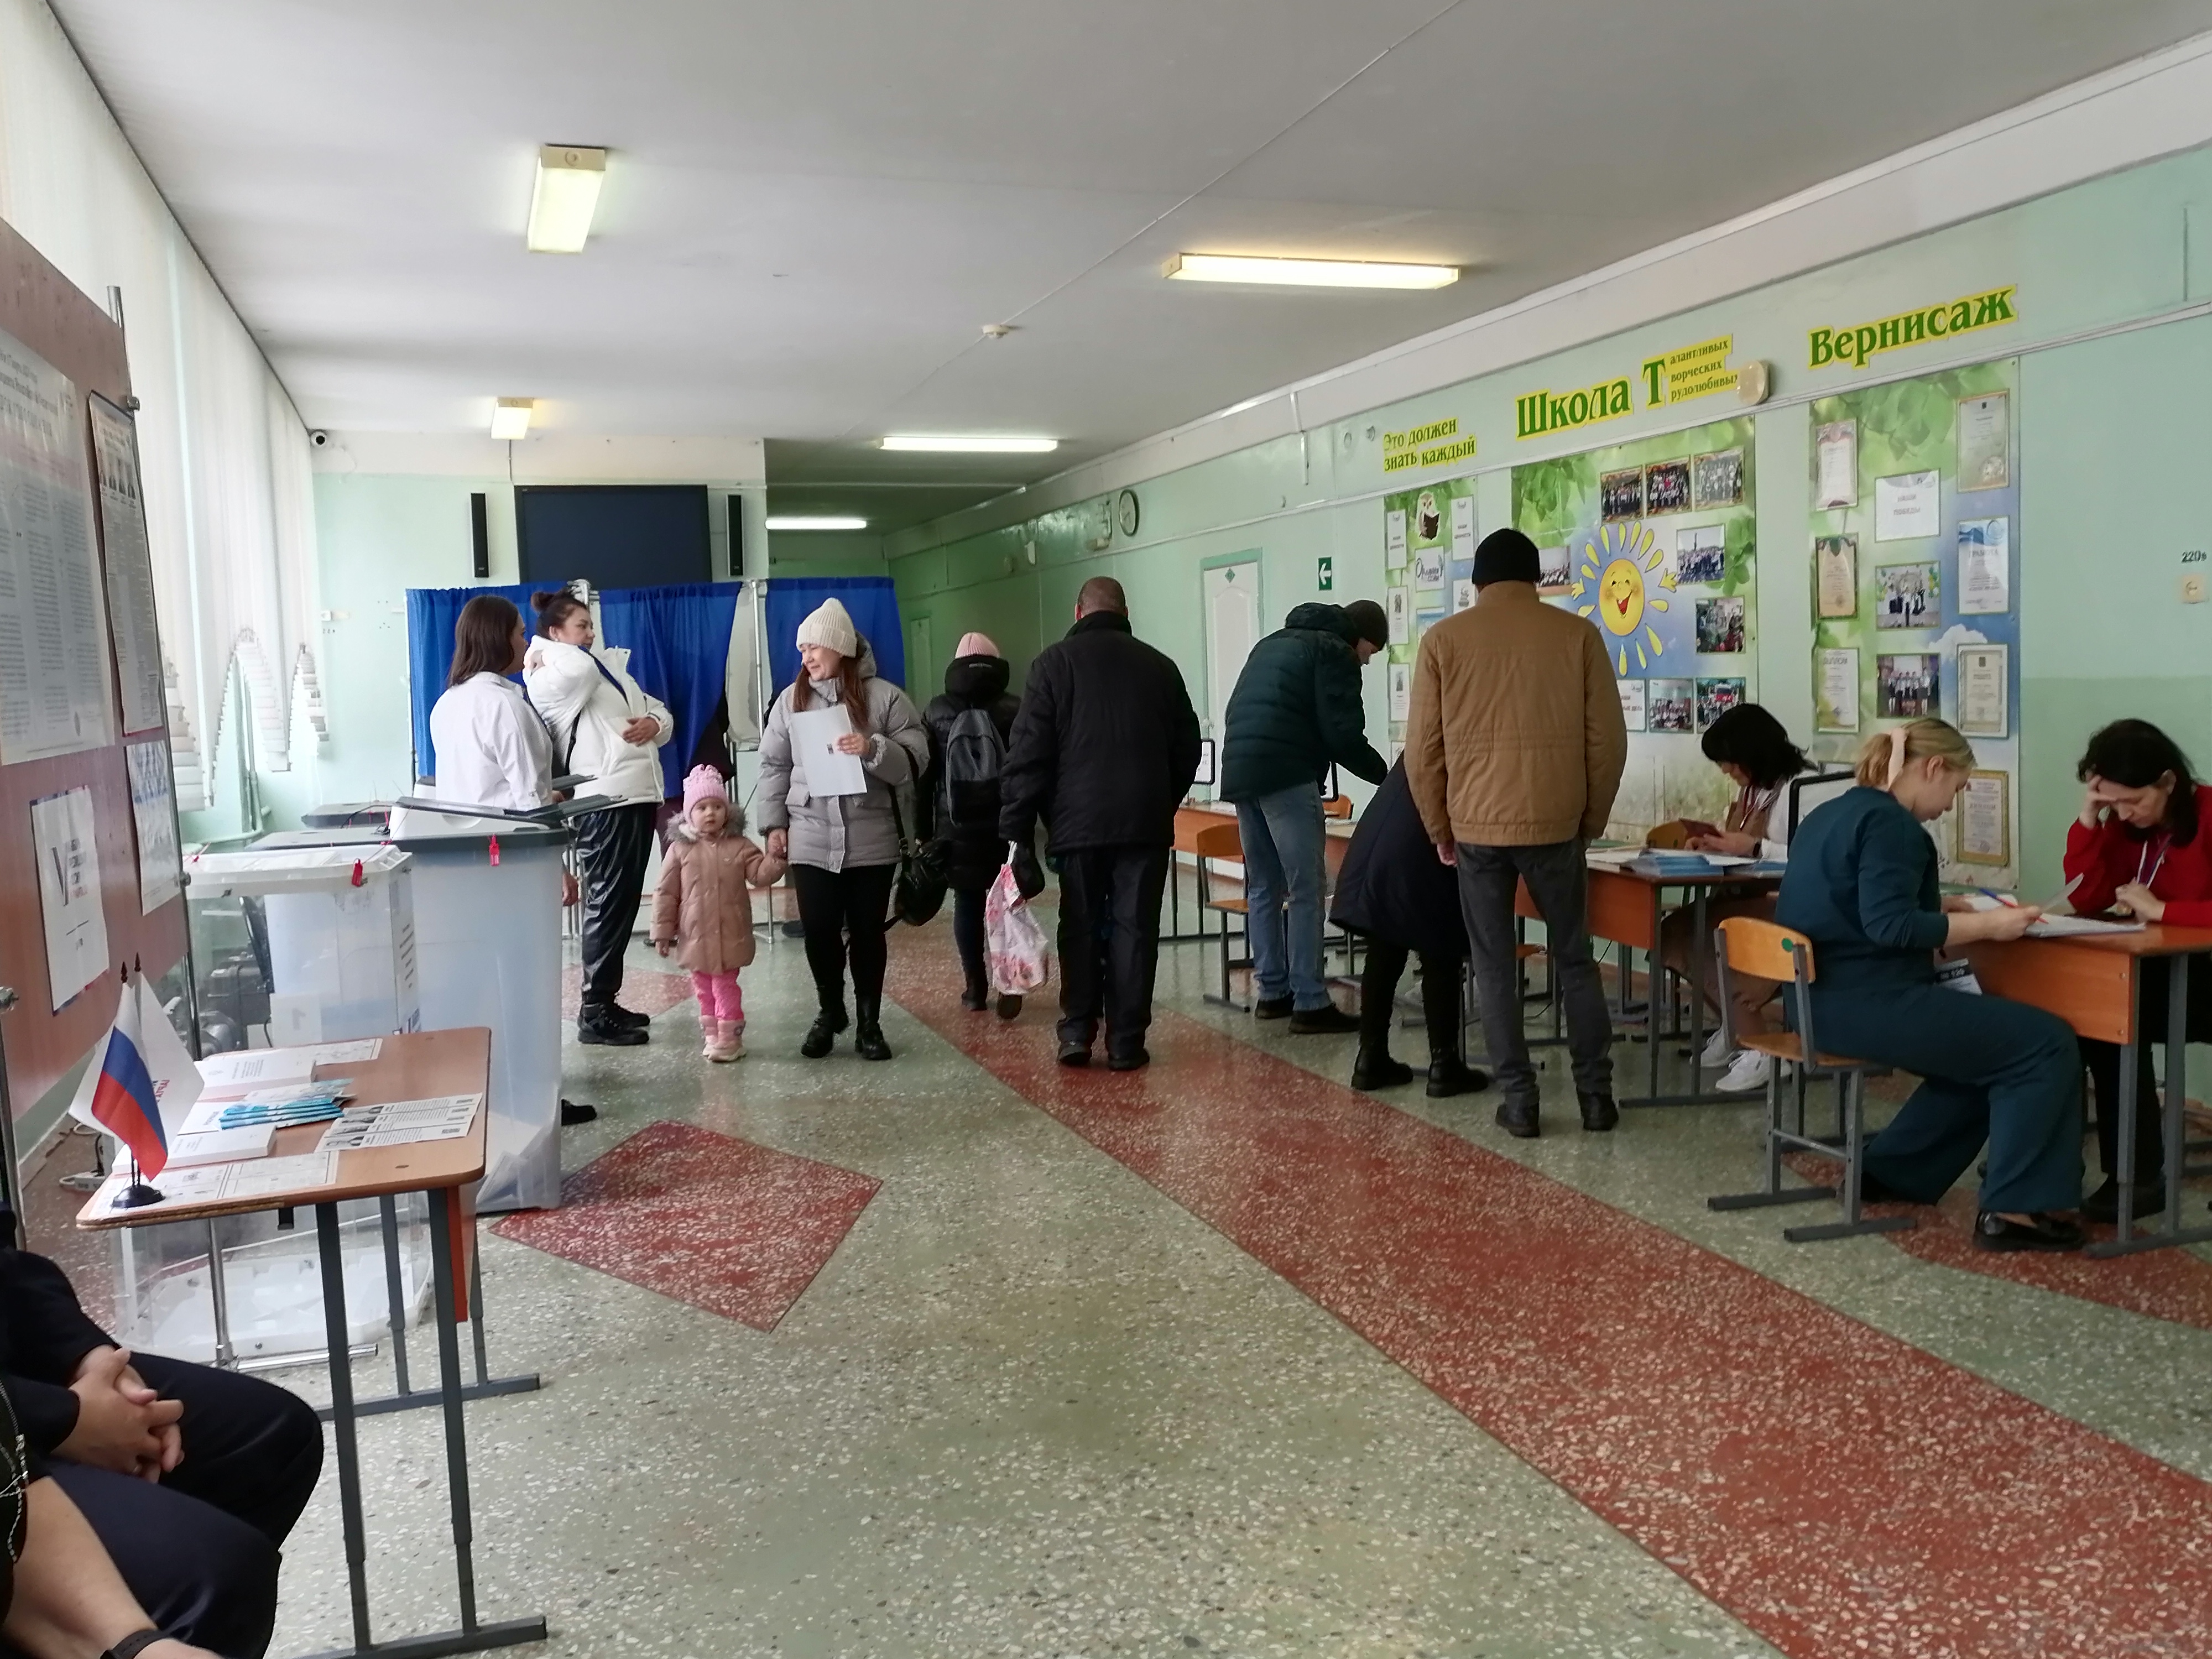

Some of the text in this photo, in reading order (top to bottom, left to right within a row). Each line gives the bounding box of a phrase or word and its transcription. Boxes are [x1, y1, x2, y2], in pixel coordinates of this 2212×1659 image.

[1811, 289, 2013, 367] Вернисаж
[1670, 340, 1729, 365] алантливых
[1671, 360, 1722, 383] ворческих
[1517, 359, 1666, 437] Школа Т
[1384, 419, 1457, 451] Это должен
[1385, 435, 1475, 471] знать каждый
